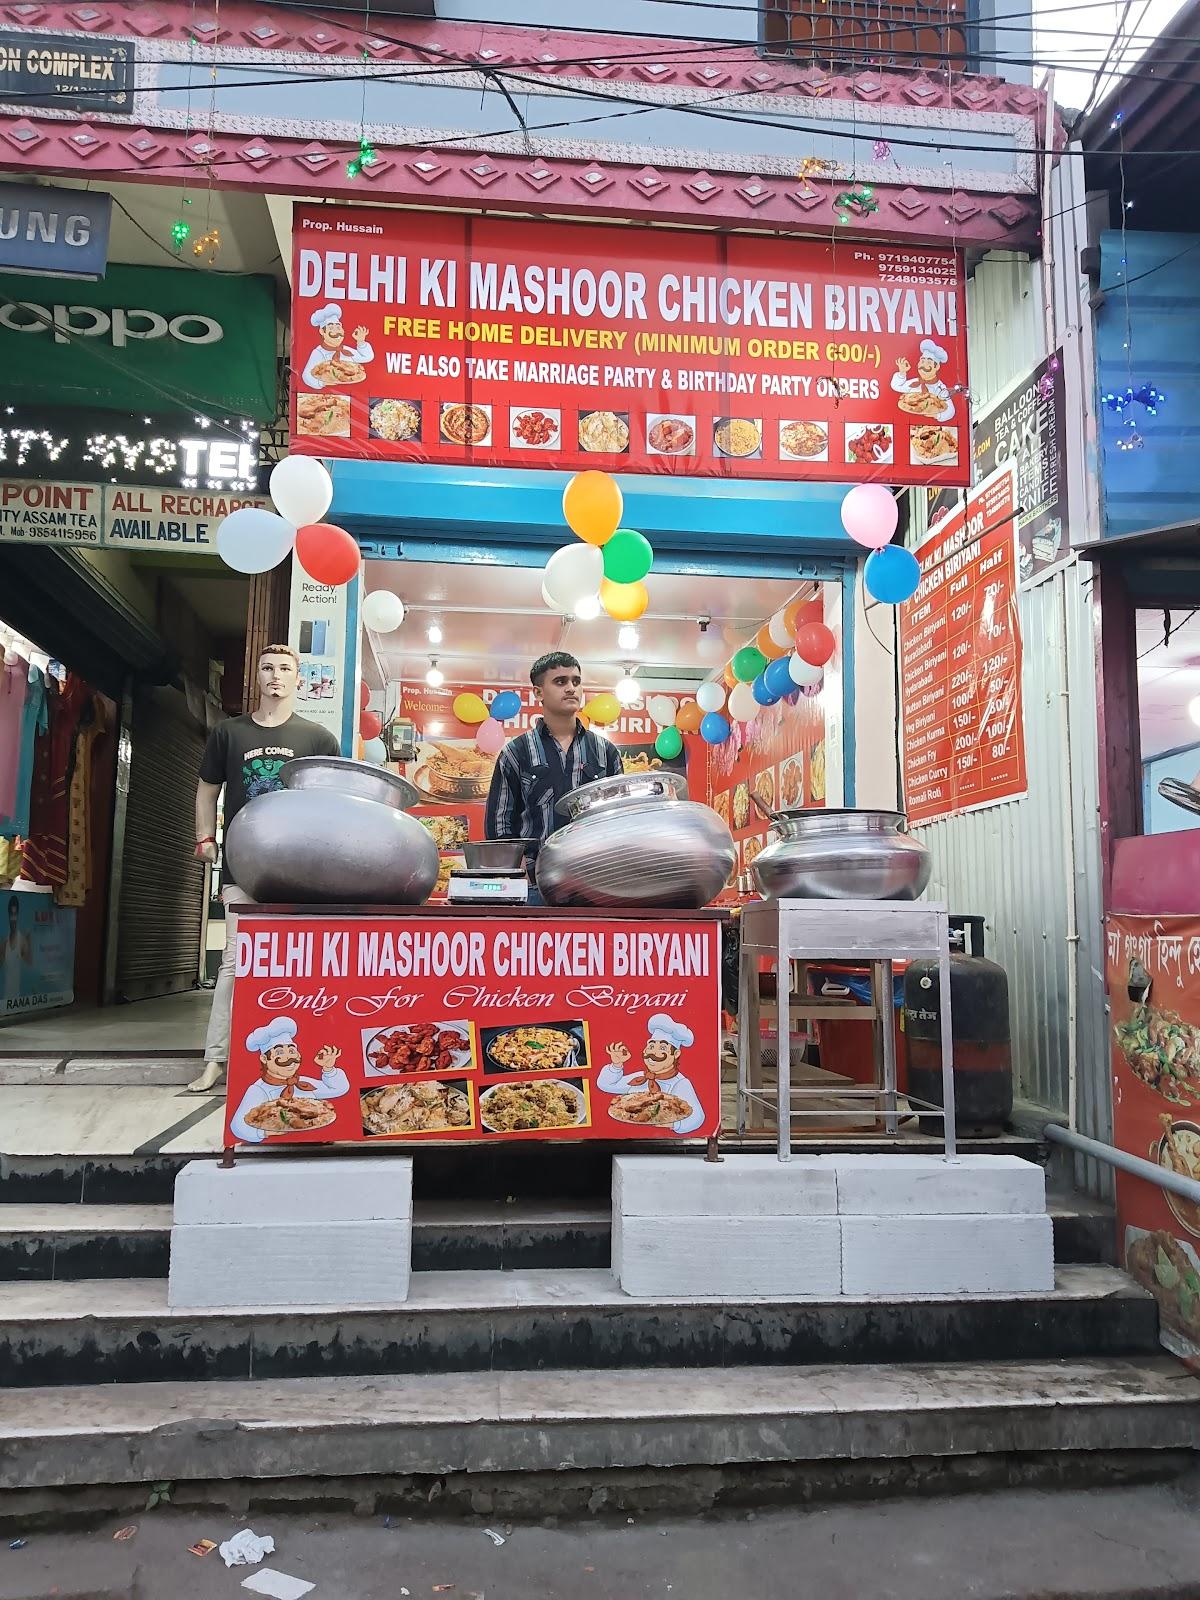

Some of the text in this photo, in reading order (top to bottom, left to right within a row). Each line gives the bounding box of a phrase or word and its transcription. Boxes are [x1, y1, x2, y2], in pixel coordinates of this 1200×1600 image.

[26, 49, 115, 81] COMPLEX
[302, 219, 384, 234] Prop. Hussain
[854, 252, 957, 266] Ph. 9719407754
[878, 263, 957, 276] 9759134025
[298, 249, 957, 336] DELHI KI MASHOOR CHICKEN BIRYANI
[878, 274, 957, 286] 7248093578
[383, 315, 881, 368] FREE HOME DELIVERY (MINIMUM ORDER 600/-)
[385, 352, 879, 400] WE ALSO TAKE MARRIAGE PARTY & BIRTHDAY PARTY ORDERS
[995, 425, 1009, 443] TEA
[1011, 418, 1016, 429] &
[1048, 398, 1056, 437] CREAM
[995, 402, 1048, 467] CAKE
[1020, 446, 1048, 475] BAKERY
[1049, 438, 1057, 475] FRESH
[1020, 458, 1048, 487] ITEMS
[1020, 469, 1049, 498] CANDLE
[2, 484, 94, 510] POINT
[112, 492, 152, 513] ALL
[1020, 475, 1058, 512] KNIFE
[23, 511, 67, 526] ASSAM
[70, 513, 98, 528] TEA
[110, 519, 210, 543] AVAILABLE
[945, 540, 981, 580] BIRIYANI
[302, 595, 337, 604] Action!
[912, 549, 1002, 626] ITEM Full Half
[951, 601, 971, 621] 120/-
[952, 640, 971, 660] 120/-
[953, 711, 976, 729] 150/-
[244, 747, 294, 761] HERE COMES
[927, 749, 937, 761] Fry
[955, 732, 978, 751] 200/-
[929, 767, 948, 780] Curry
[957, 753, 977, 770] 150/-
[992, 741, 1010, 758] 80/-
[235, 932, 709, 977] DELHI KI MASHOOR CHICKEN BIRYANI
[7, 997, 30, 1010] RANA
[32, 994, 48, 1006] DAS
[258, 984, 688, 1016] Only For Chicken Biryani
